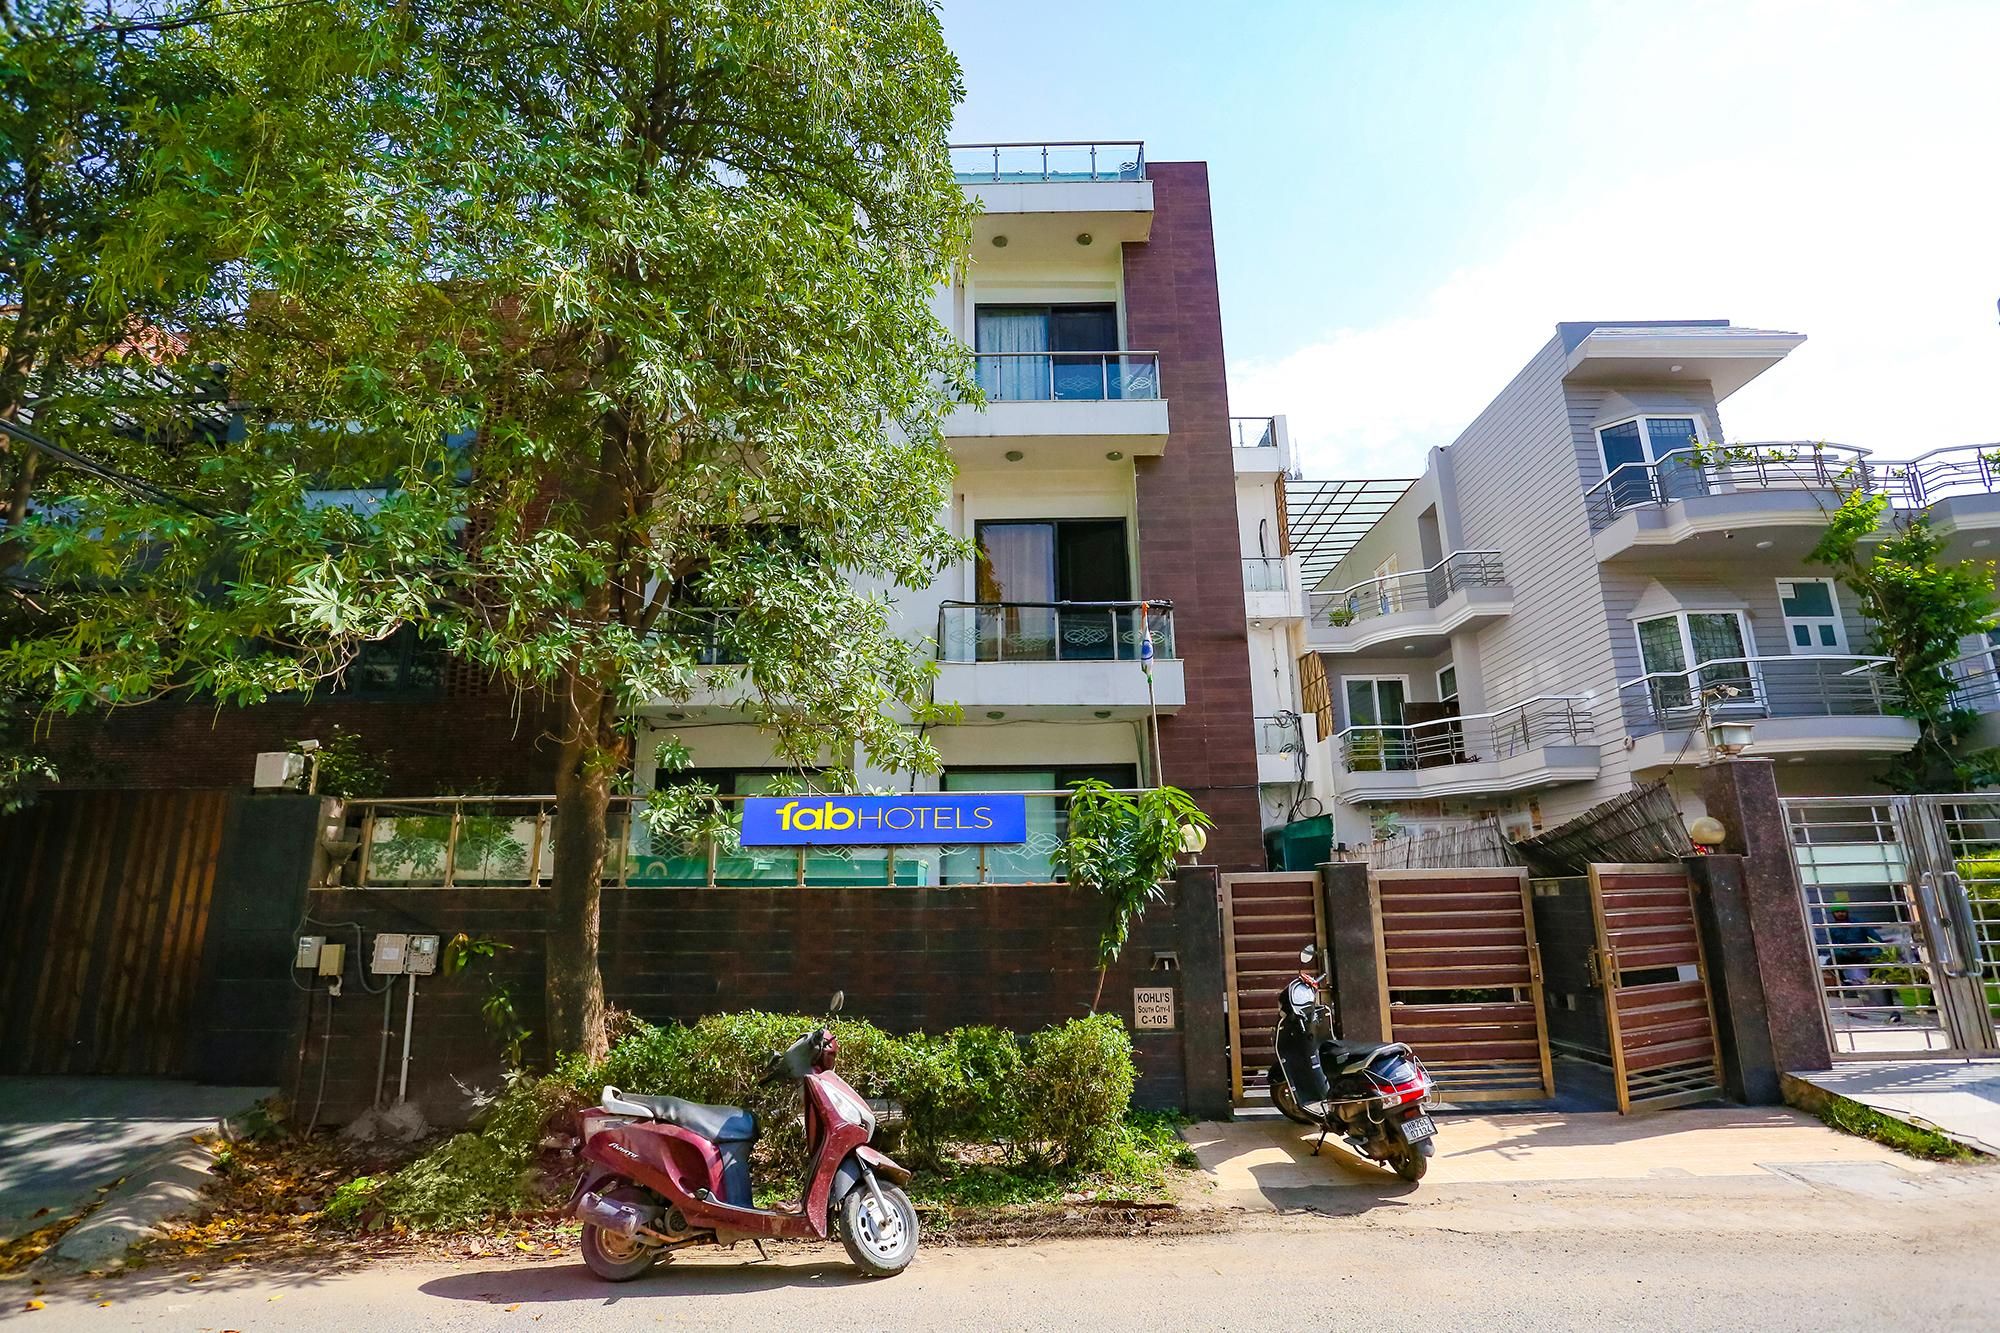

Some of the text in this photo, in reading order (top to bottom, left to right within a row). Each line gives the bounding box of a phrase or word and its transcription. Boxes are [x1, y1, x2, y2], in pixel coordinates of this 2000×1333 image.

[776, 801, 993, 831] fabHOTELS
[1137, 992, 1170, 1003] KOHLI'S
[1141, 1015, 1168, 1024] C-105
